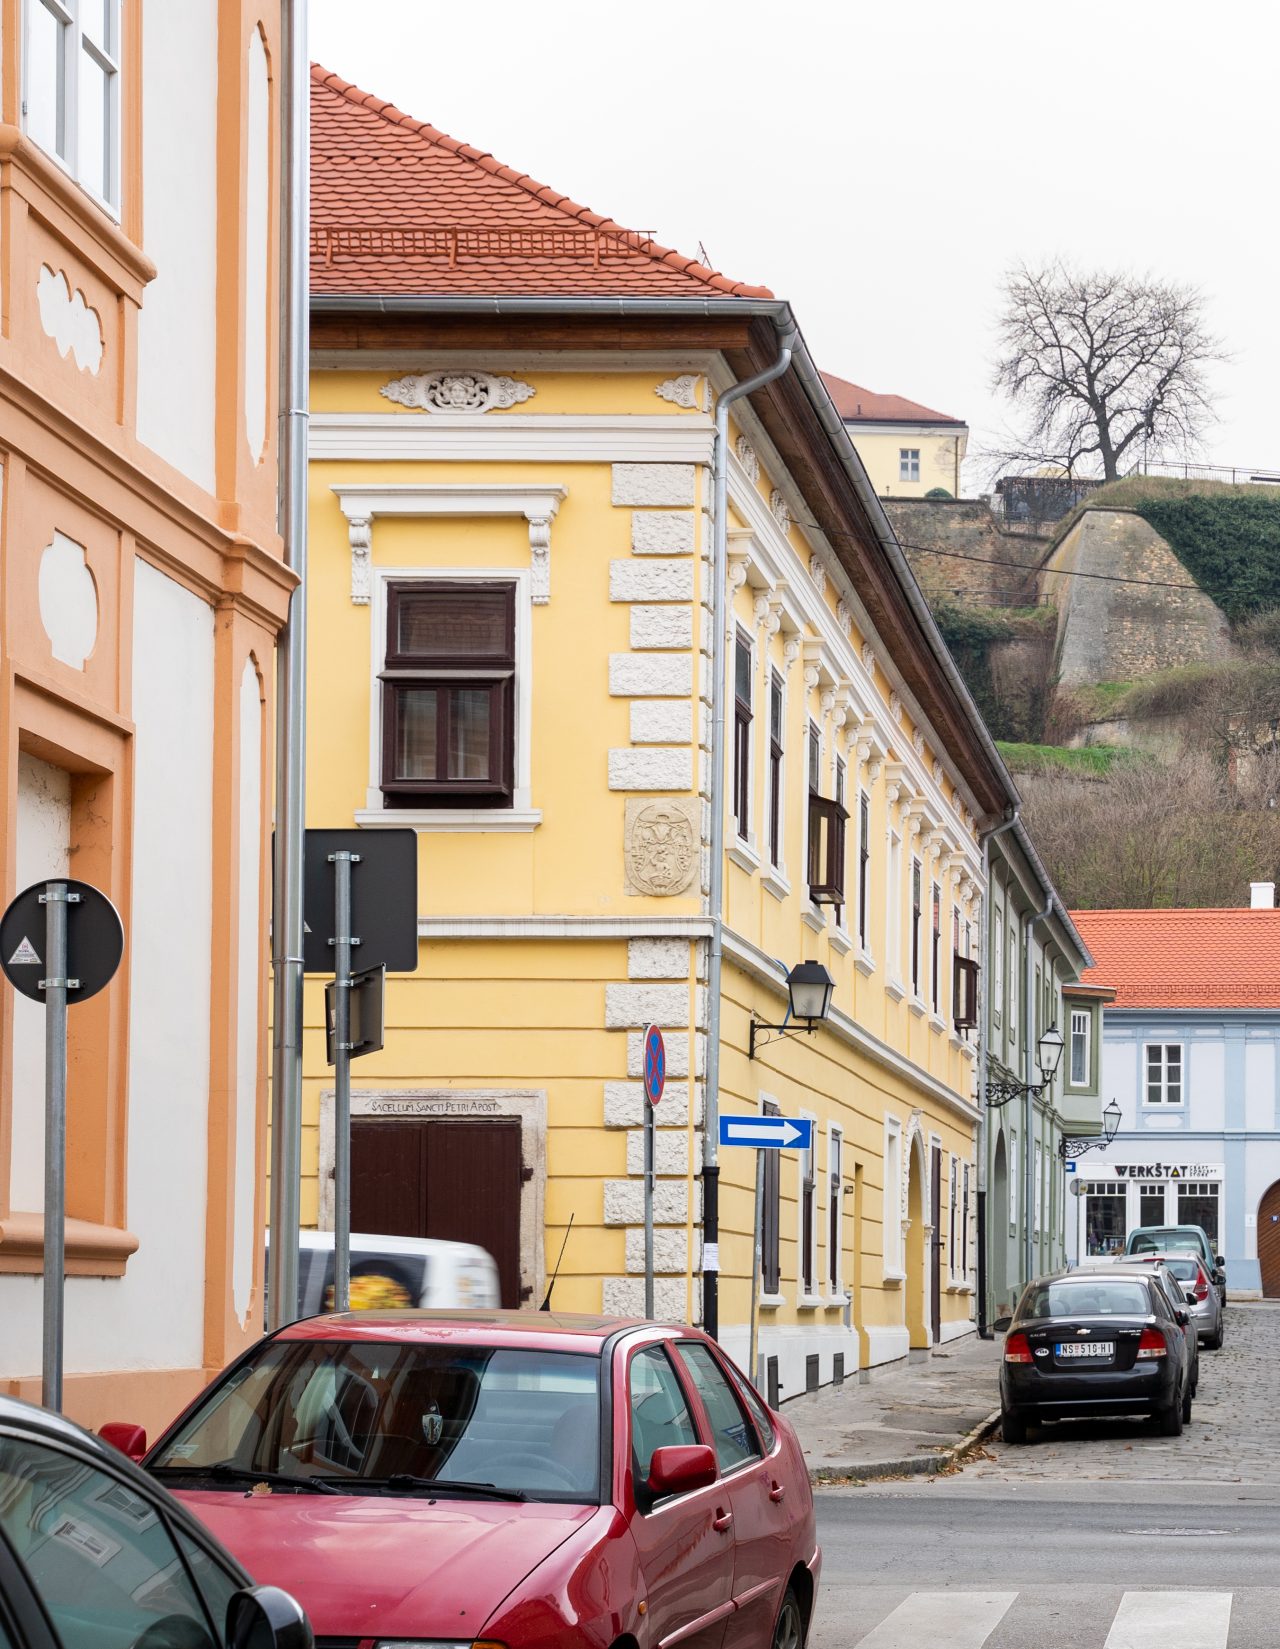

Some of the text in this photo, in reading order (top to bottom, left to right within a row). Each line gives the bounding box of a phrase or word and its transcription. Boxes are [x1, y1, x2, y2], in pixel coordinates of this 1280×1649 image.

[445, 1101, 469, 1112] PETRI
[470, 1101, 497, 1112] APOST
[1114, 1163, 1188, 1178] WERKŠTAT
[1062, 1344, 1074, 1354] NS
